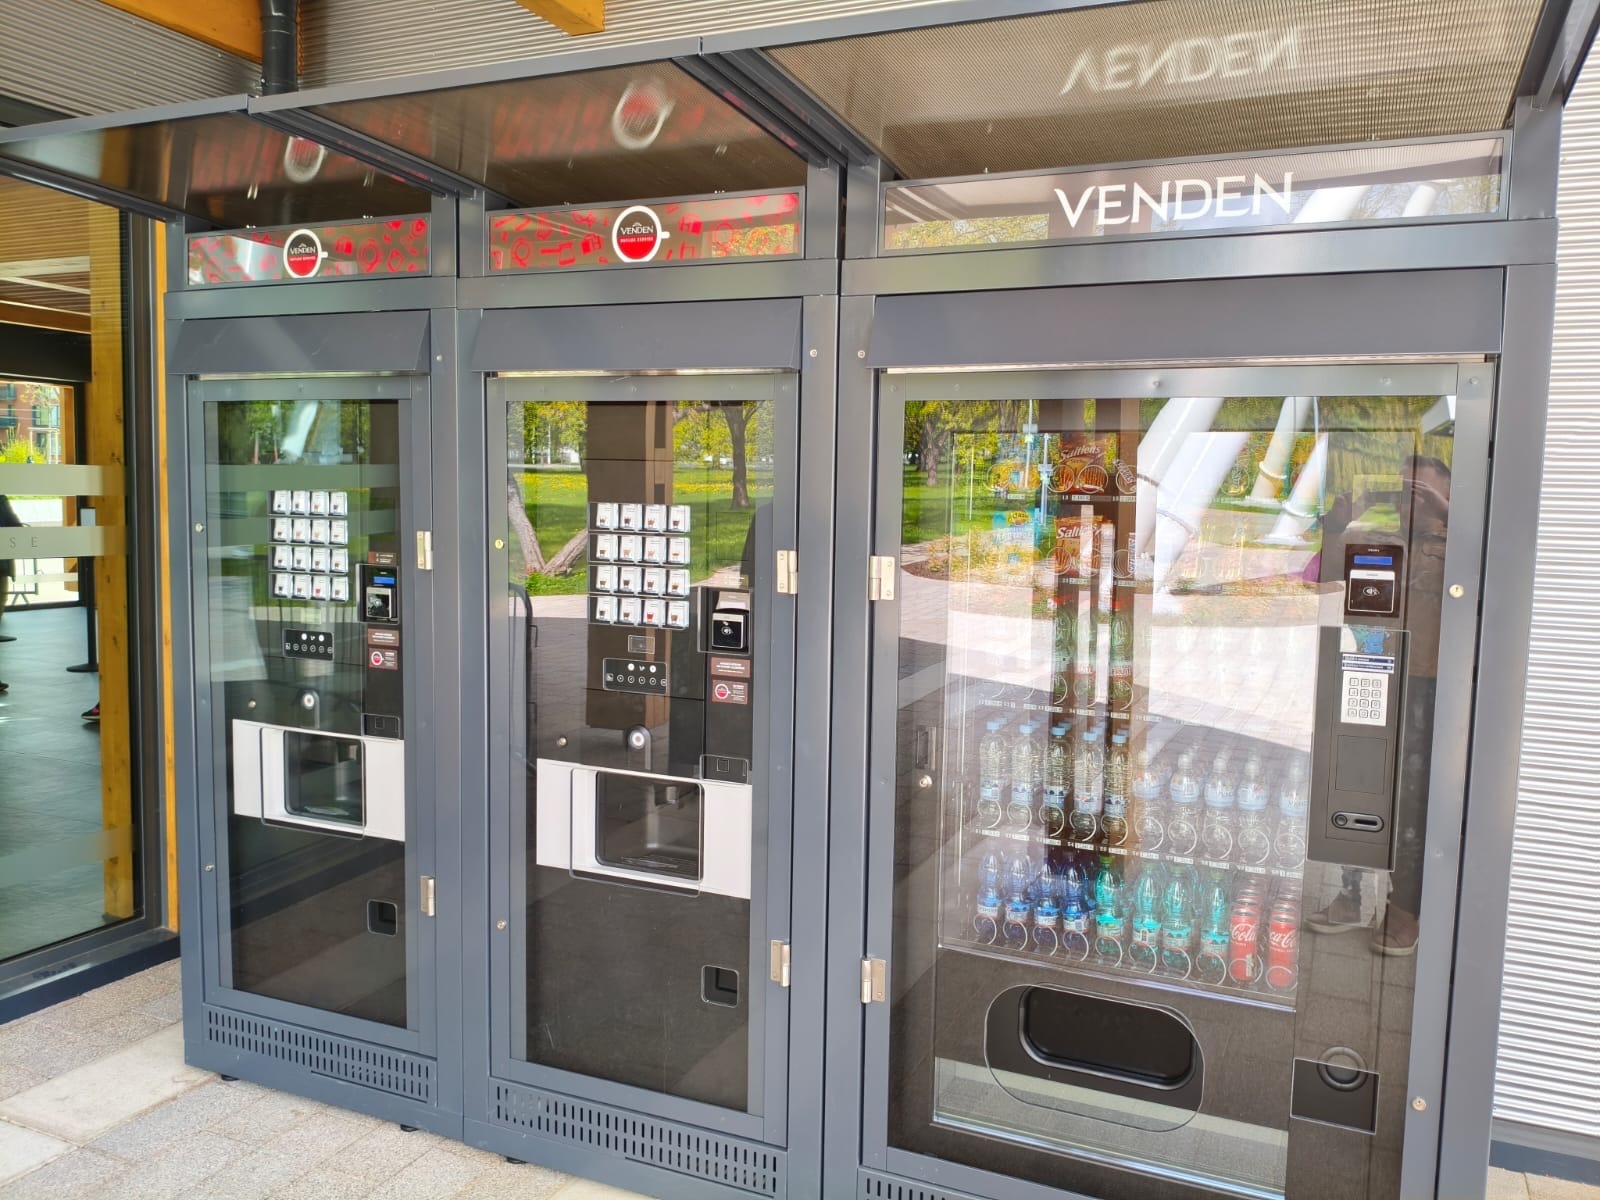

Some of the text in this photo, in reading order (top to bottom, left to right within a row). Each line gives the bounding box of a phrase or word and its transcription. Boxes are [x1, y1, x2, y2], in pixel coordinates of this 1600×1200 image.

[1054, 171, 1294, 228] VENDEN
[620, 225, 654, 235] VENDEN
[290, 246, 316, 255] VENDEN
